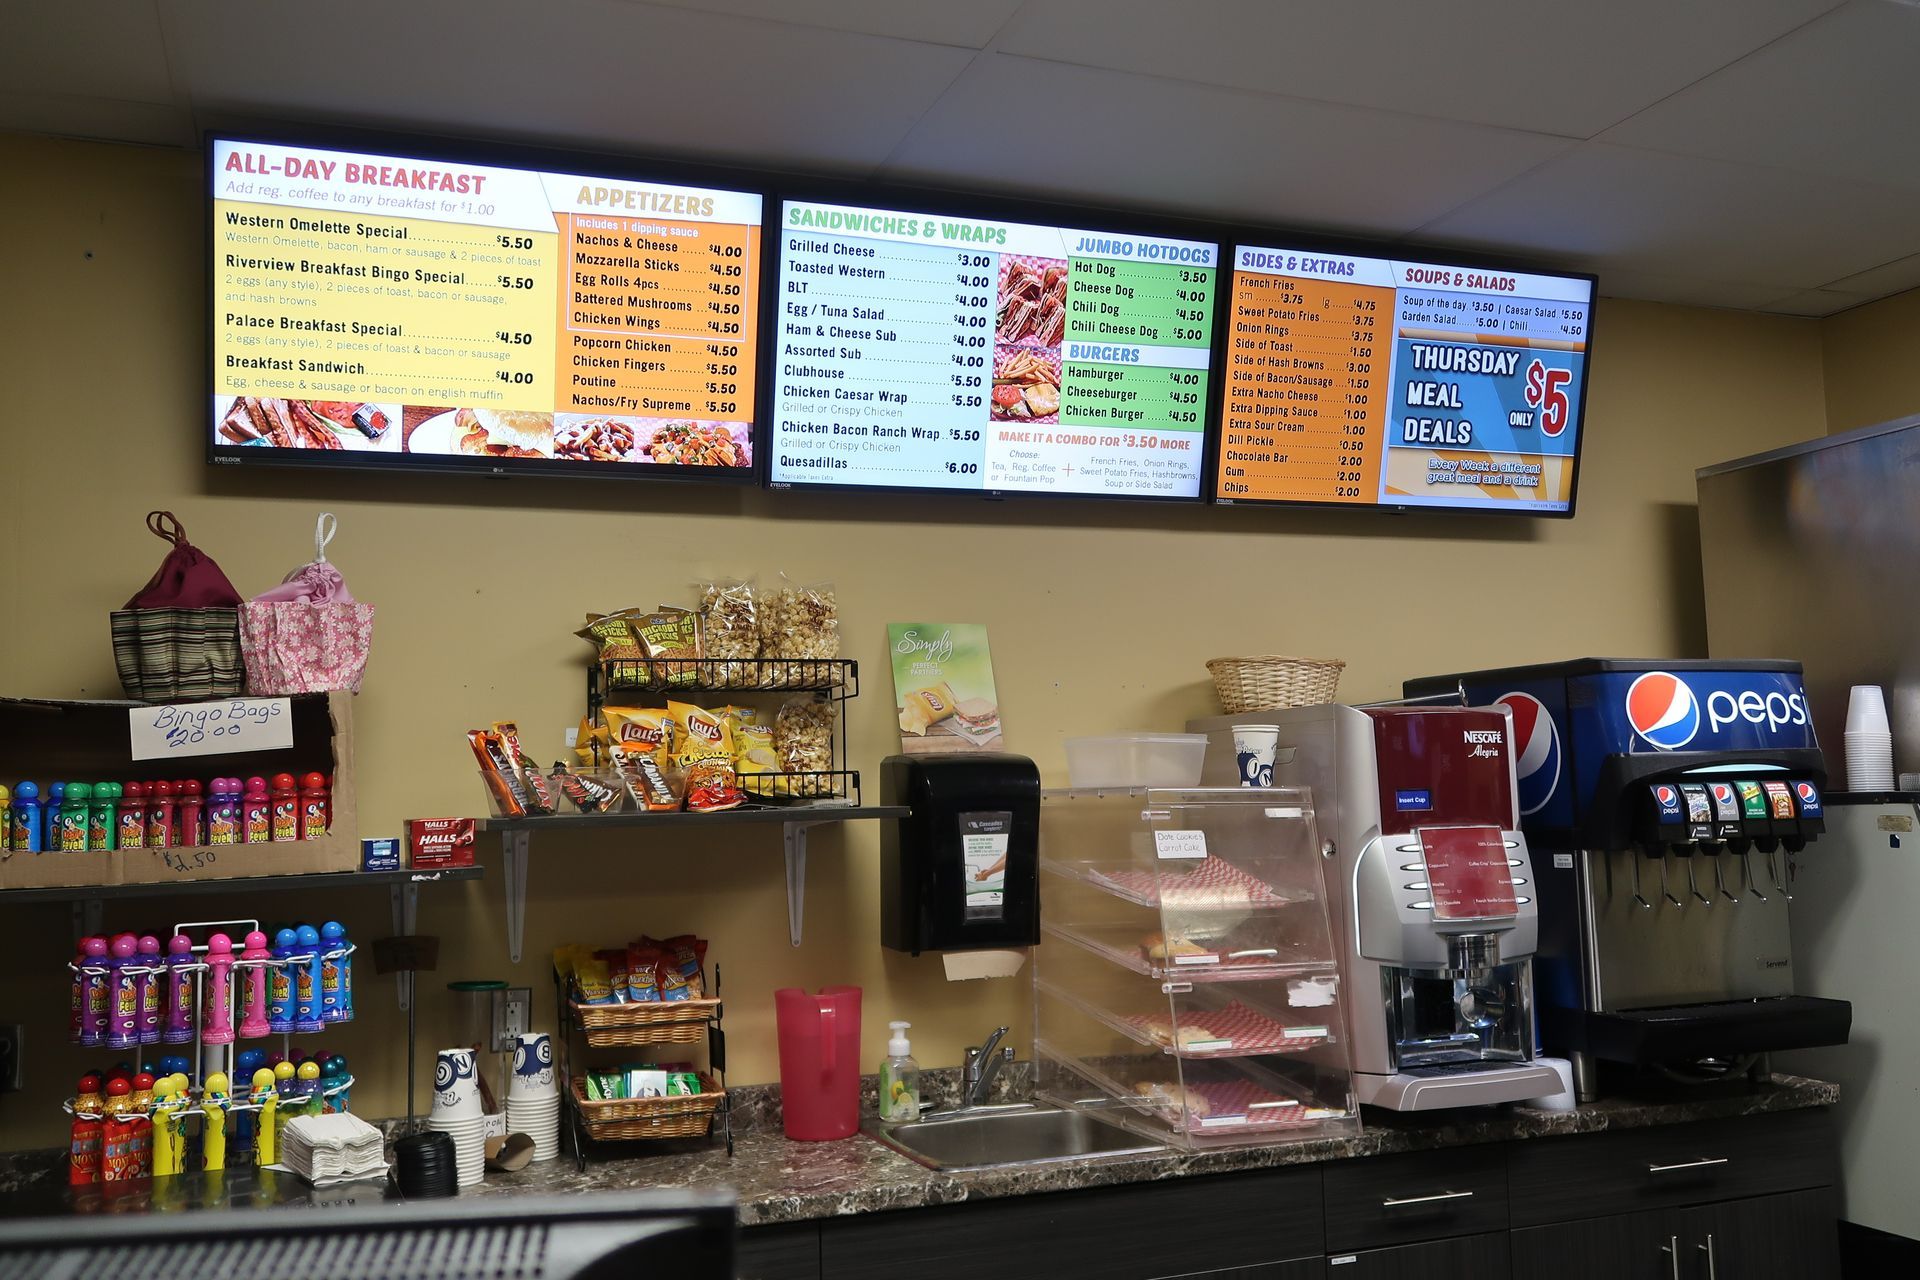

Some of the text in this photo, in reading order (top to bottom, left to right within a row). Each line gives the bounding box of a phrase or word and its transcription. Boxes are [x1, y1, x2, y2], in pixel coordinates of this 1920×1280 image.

[225, 151, 485, 195] ALL-DAY BREAKFAST
[226, 180, 494, 215] Add reg. coffee to any breakfast for $1.00
[576, 184, 714, 217] APPETIZERS
[226, 212, 532, 249] Western Omelette Special $5.50
[575, 216, 618, 231] Includes
[630, 221, 666, 236] dipping
[669, 226, 698, 238] sauce
[789, 207, 1006, 244] SANDWICHES & WRAPS
[576, 232, 742, 257] Nachos & Cheese $4.00
[789, 238, 990, 268] Grilled Cheese $3.00
[1076, 236, 1210, 264] JUMBO HOTDOGS
[226, 254, 533, 289] Riverview Breakfast Bingo Special $5.50
[1075, 261, 1206, 283] Hot Dog $3.50
[1241, 252, 1354, 276] SIDES & EXTRAS
[1239, 276, 1294, 290] French Fries
[1405, 268, 1515, 292] SOUPS & SALADS
[788, 281, 987, 307] BLT $4.00
[787, 302, 807, 316] Egg
[820, 304, 847, 317] Tuna
[852, 307, 884, 320] Salad
[953, 314, 986, 328] $4.00
[1403, 295, 1423, 307] Soup
[1426, 297, 1434, 306] of
[1436, 298, 1449, 308] the
[1452, 299, 1466, 311] day
[1472, 301, 1494, 312] $3.50
[1505, 304, 1531, 315] Caesar
[1534, 307, 1556, 317] Salad
[1561, 309, 1582, 320] $5.50
[226, 313, 532, 344] Palace Breakfast Special $4.50
[1069, 343, 1140, 363] BURGERS
[1234, 354, 1371, 373] Side of Hash Browns $3.00
[1412, 344, 1519, 375] THURSDAY
[226, 355, 533, 384] Breakfast Sandwich $4.00
[573, 374, 736, 394] Poutine $5.50
[1067, 385, 1197, 403] Cheeseburger $4.50
[1407, 382, 1463, 408] MEAL
[1525, 360, 1572, 437] $5
[782, 420, 979, 441] Chicken Bacon Ranch Wrap $5.50
[1509, 411, 1532, 427] ONLY
[999, 431, 1190, 450] MAKE IT A COMBO FOR $3.50 MORE
[1404, 418, 1471, 444] DEALS
[780, 454, 976, 474] Quesadillas $6.00
[1428, 457, 1541, 474] Every Week a different
[1223, 482, 1360, 496] Chips $2.00
[1426, 471, 1538, 487] great meal and a drink
[641, 623, 678, 636] HICKORY
[648, 632, 678, 643] STICKS
[897, 630, 953, 662] Simply
[153, 702, 281, 729] Bingo Bags
[622, 723, 659, 742] Lay's
[690, 716, 720, 739] Lay's
[1464, 730, 1502, 744] NESCAFÉ
[1468, 744, 1498, 758] Alegria
[419, 834, 457, 846] HALLS
[1159, 843, 1182, 852] Carrot
